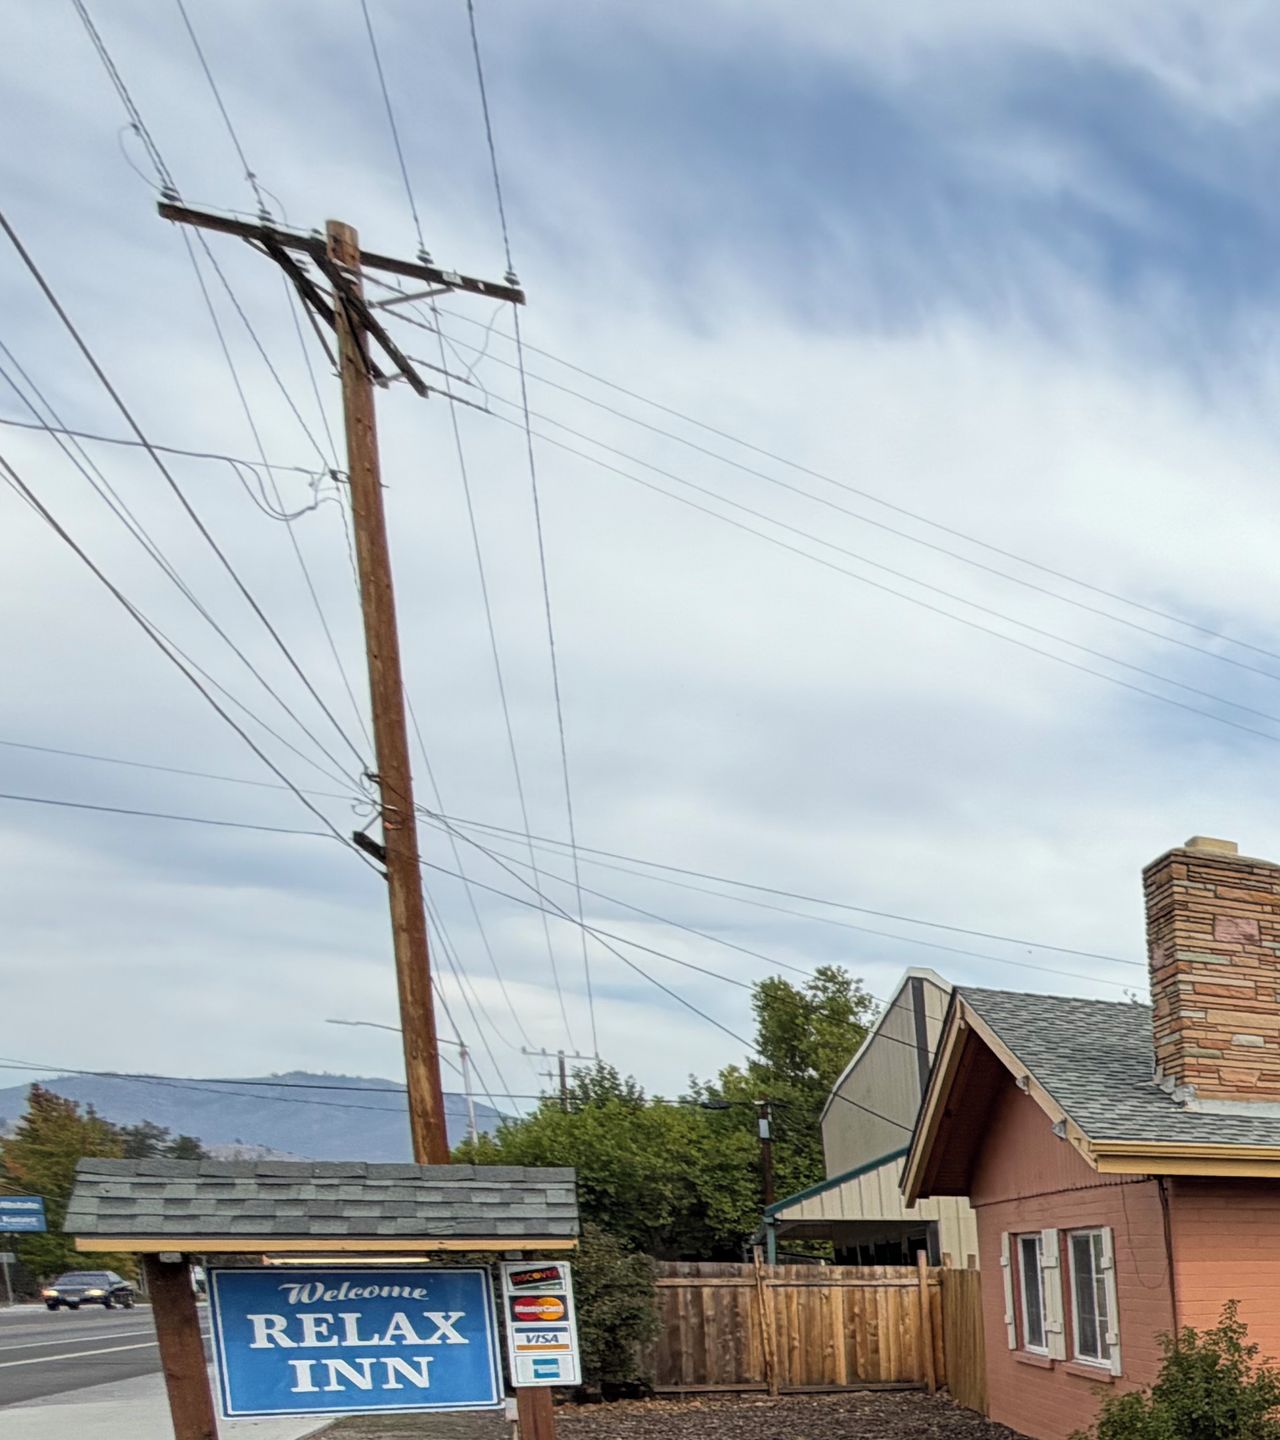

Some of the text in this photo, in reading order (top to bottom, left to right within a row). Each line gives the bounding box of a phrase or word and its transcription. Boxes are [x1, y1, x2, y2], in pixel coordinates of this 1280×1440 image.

[278, 1281, 429, 1305] Welcome
[247, 1311, 469, 1349] RELAX
[526, 1333, 560, 1344] VISA
[288, 1356, 434, 1393] INN
